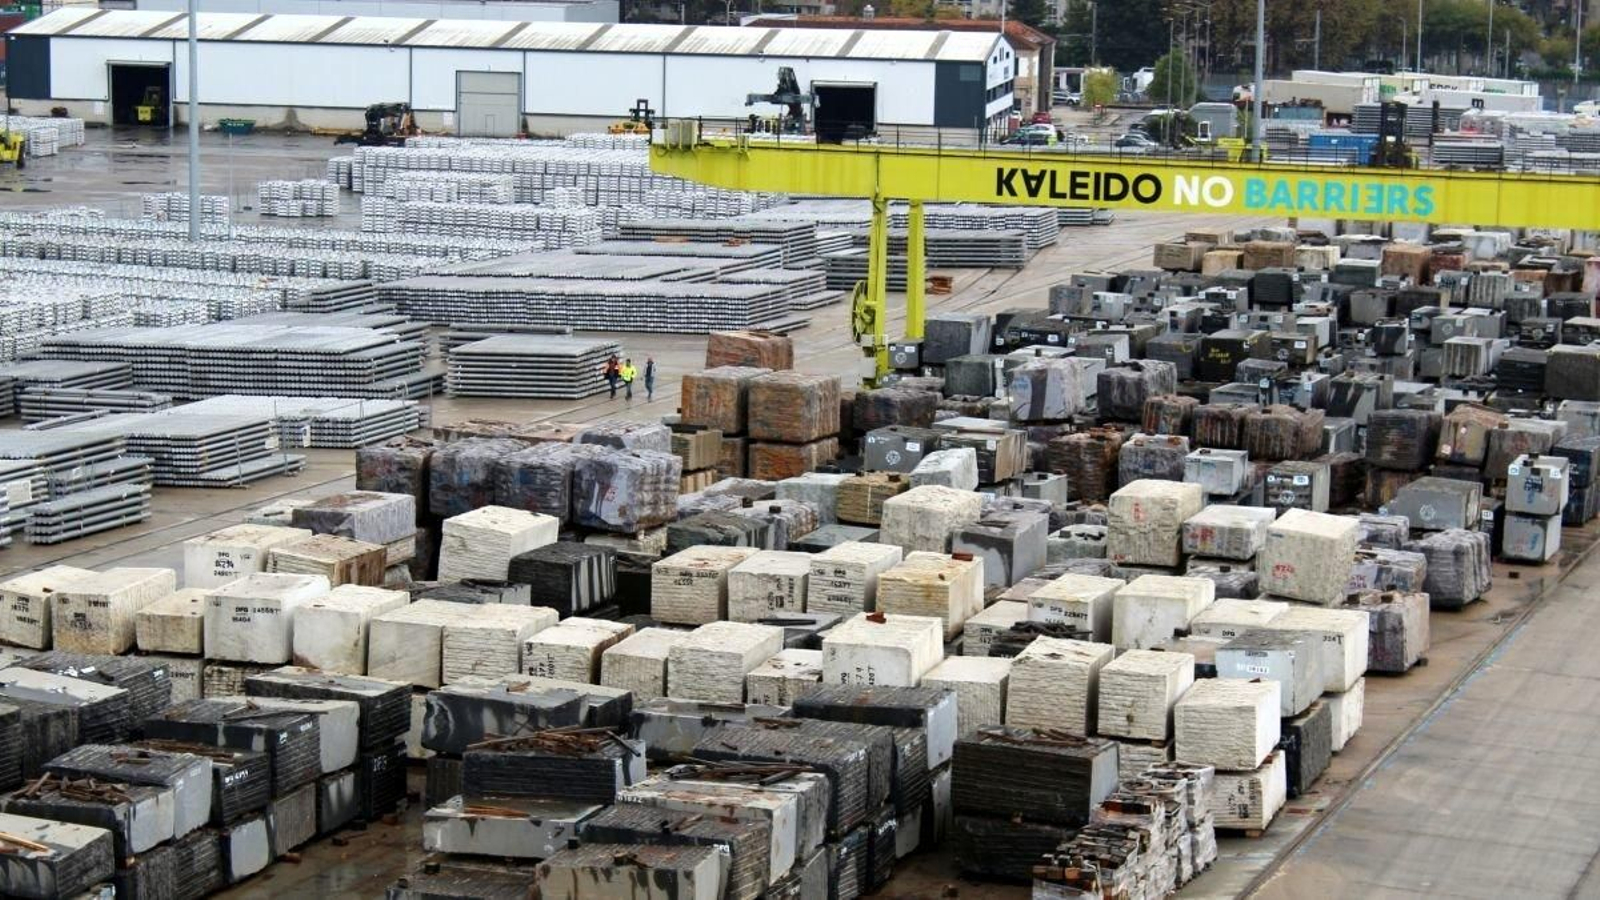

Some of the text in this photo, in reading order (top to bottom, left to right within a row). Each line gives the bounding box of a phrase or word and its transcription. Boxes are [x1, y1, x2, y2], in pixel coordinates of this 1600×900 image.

[996, 168, 1435, 216] KALEIDO NO BARRIERS
